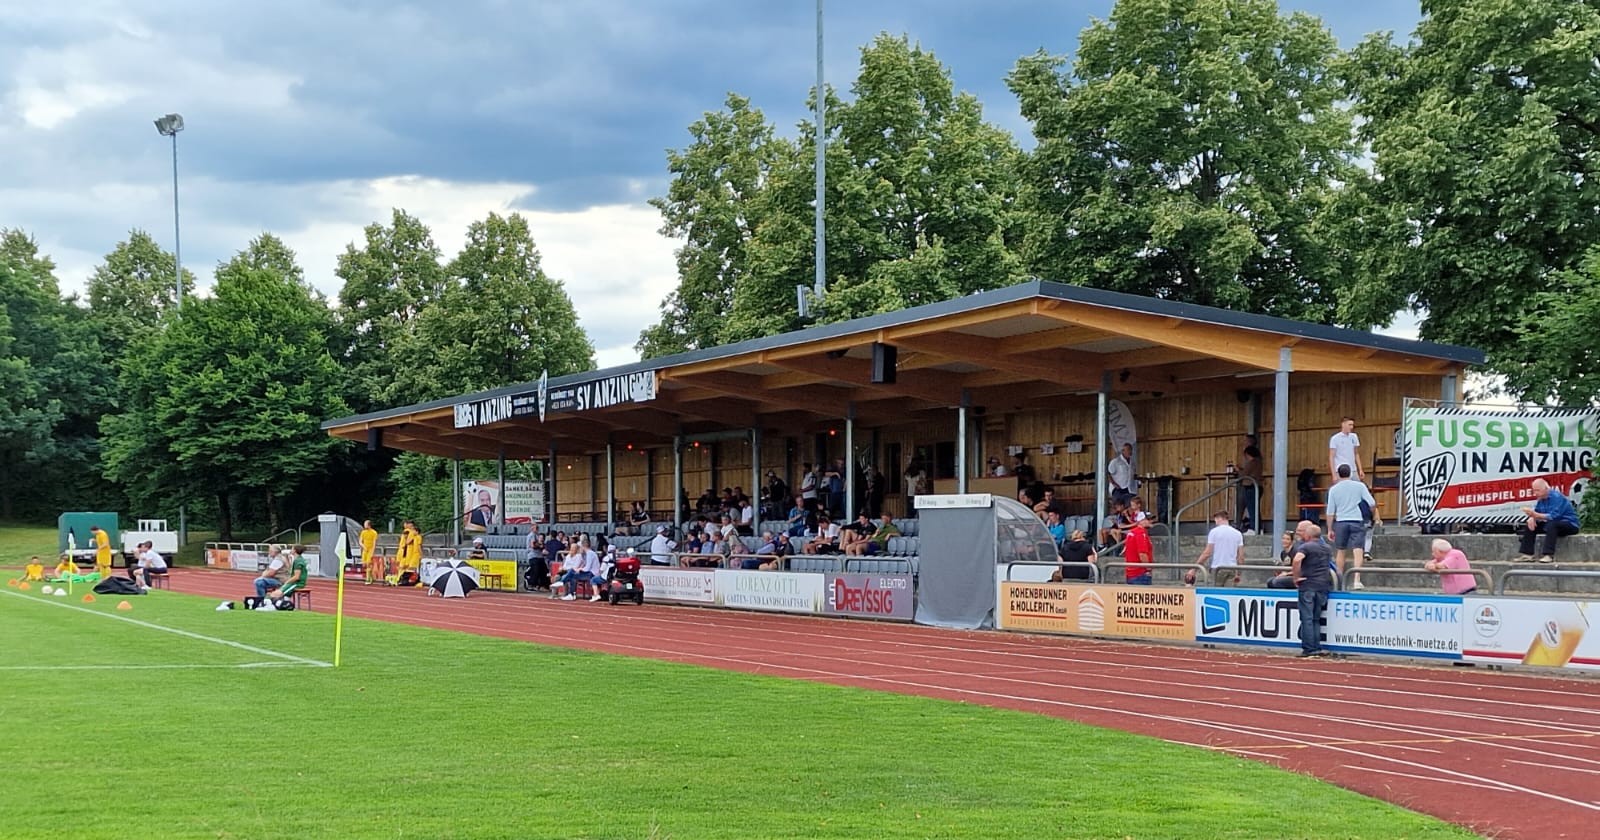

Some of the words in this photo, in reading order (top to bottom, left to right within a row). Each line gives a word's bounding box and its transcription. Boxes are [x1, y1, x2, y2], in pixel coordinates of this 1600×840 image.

[576, 384, 591, 411] SV
[480, 395, 513, 426] ANZING
[1415, 419, 1594, 448] FUSSBALL
[1416, 456, 1447, 487] SVA
[1462, 452, 1487, 473] IN
[1499, 450, 1592, 473] ANZING
[1458, 491, 1516, 504] HEIMSPIEL
[736, 575, 771, 593] LORENZ
[775, 575, 801, 595] ÖTTL
[880, 578, 906, 589] ELEKTRO
[836, 578, 893, 614] DREYSSIG
[1010, 587, 1068, 601] HOHENBRUNNER
[1116, 592, 1185, 607] HOHENBRUNNER
[1010, 600, 1015, 612] &
[1016, 600, 1055, 614] HOLLERITH
[1055, 606, 1068, 614] GmbH
[1116, 606, 1123, 618] &
[1123, 606, 1169, 620] HOLLERITH
[1169, 613, 1185, 621] GmbH
[1335, 602, 1458, 623] FERNSEHTECHNIK
[1238, 598, 1327, 642] MÜTE
[1335, 633, 1458, 650] www.fernsehtechnik-muetze.de
